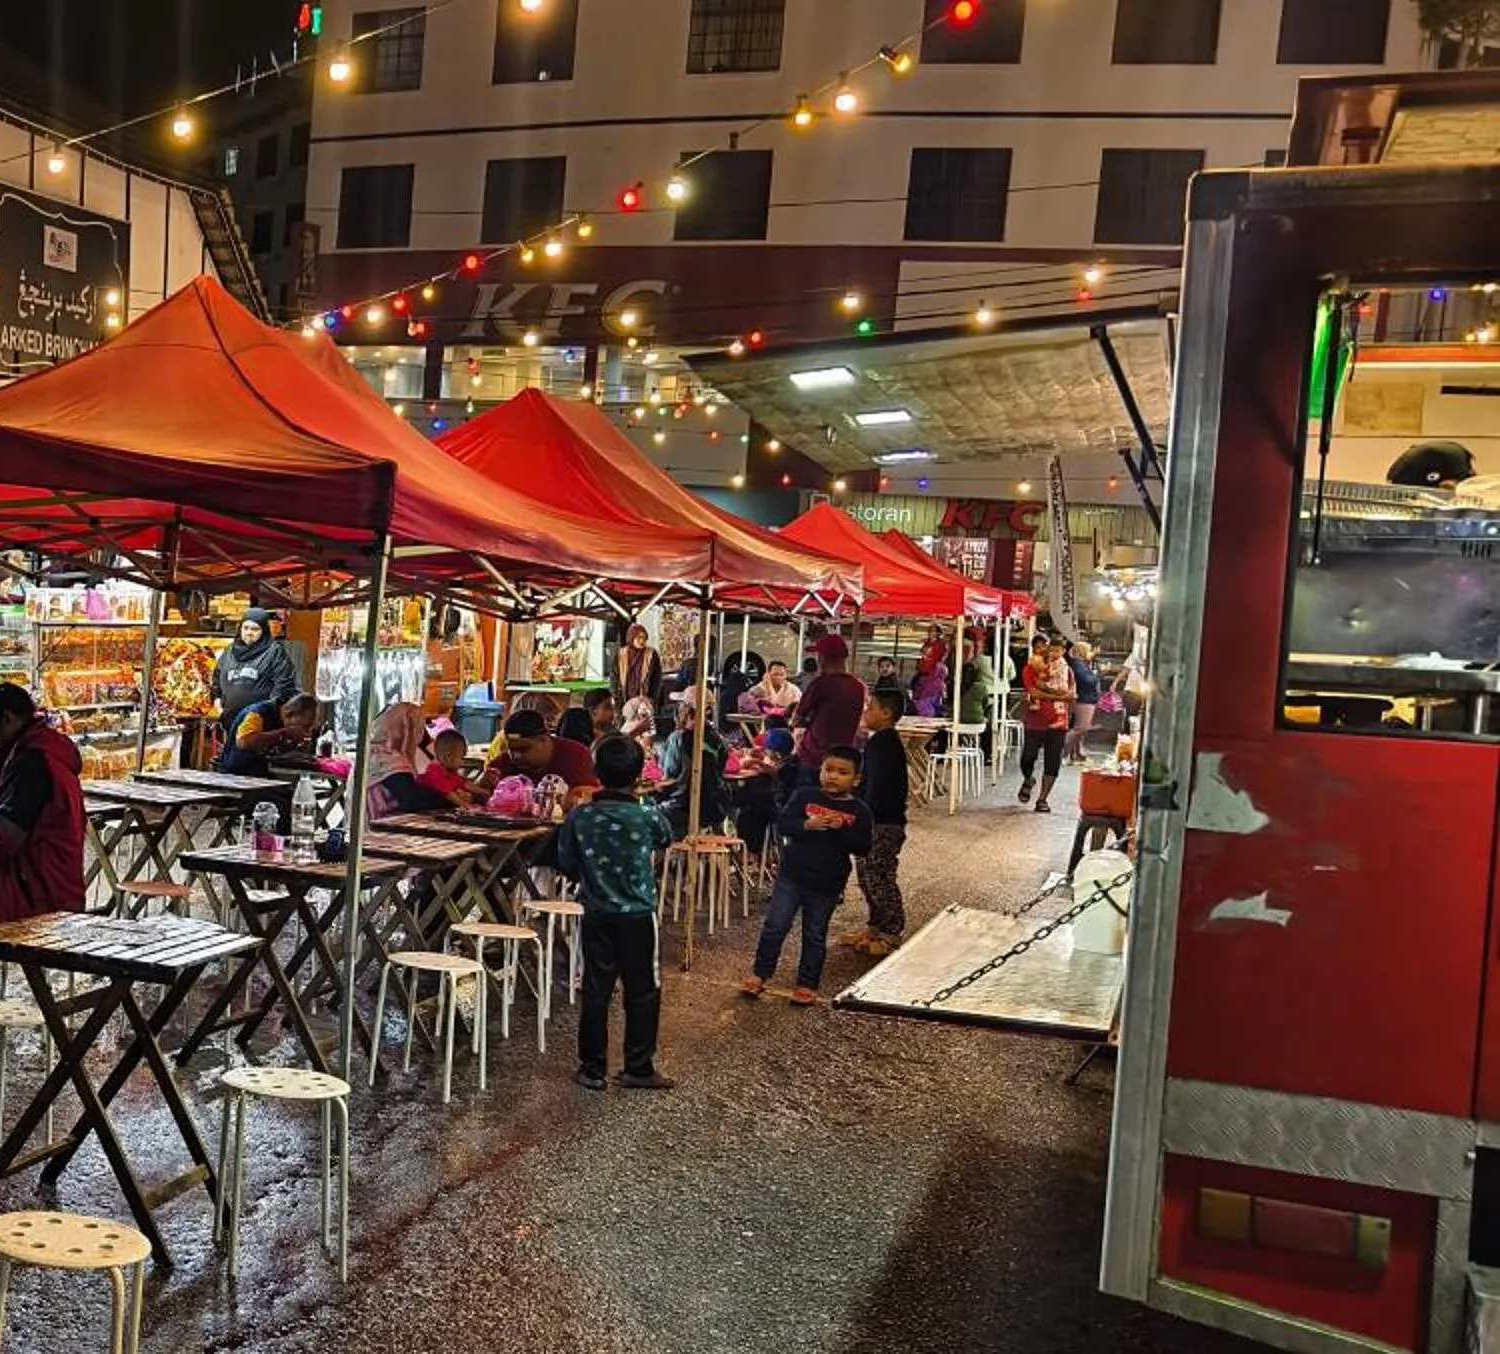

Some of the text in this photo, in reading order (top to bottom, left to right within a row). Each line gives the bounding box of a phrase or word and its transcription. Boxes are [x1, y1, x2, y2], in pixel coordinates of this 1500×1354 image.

[460, 279, 667, 338] KFC
[0, 324, 43, 355] ARKED
[846, 499, 1047, 532] storan KFC
